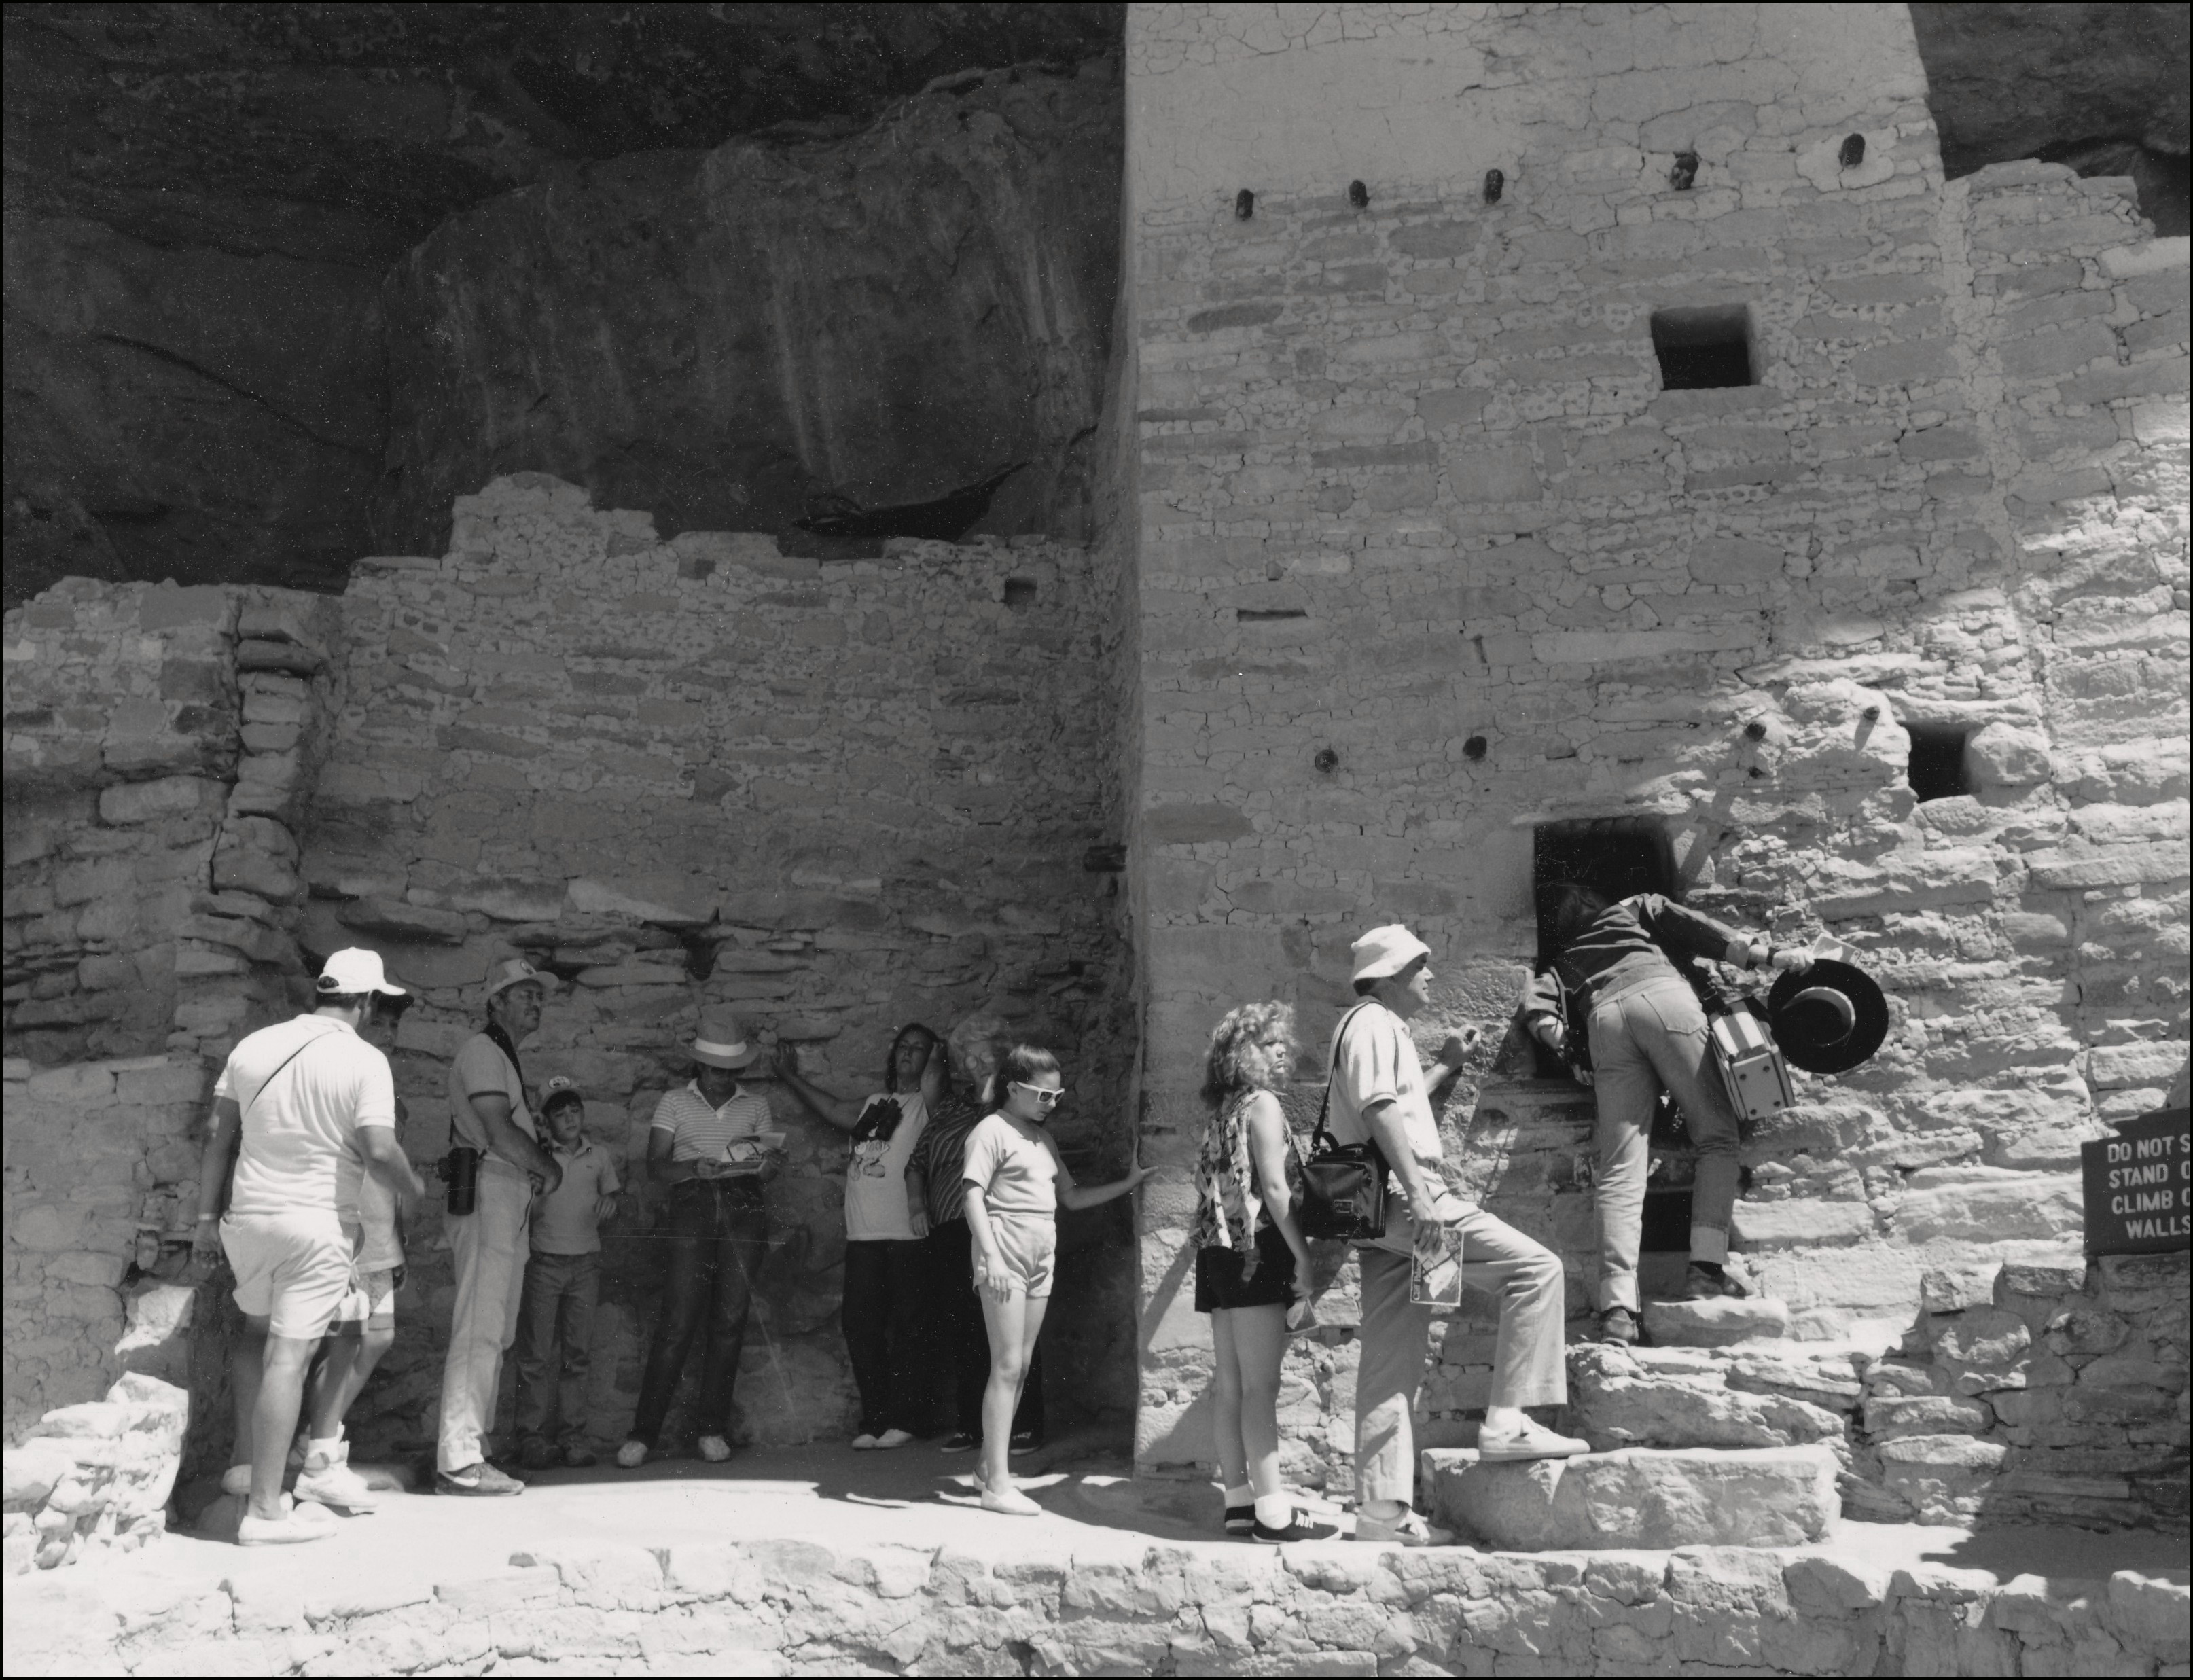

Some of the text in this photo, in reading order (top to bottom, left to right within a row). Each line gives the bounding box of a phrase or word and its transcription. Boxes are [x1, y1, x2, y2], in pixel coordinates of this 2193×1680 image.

[2107, 1142, 2132, 1162] DO
[2137, 1136, 2174, 1158] NOT
[2109, 1164, 2169, 1188] STAND
[2111, 1190, 2173, 1215] CLIMB
[2125, 1215, 2190, 1239] WALLS
